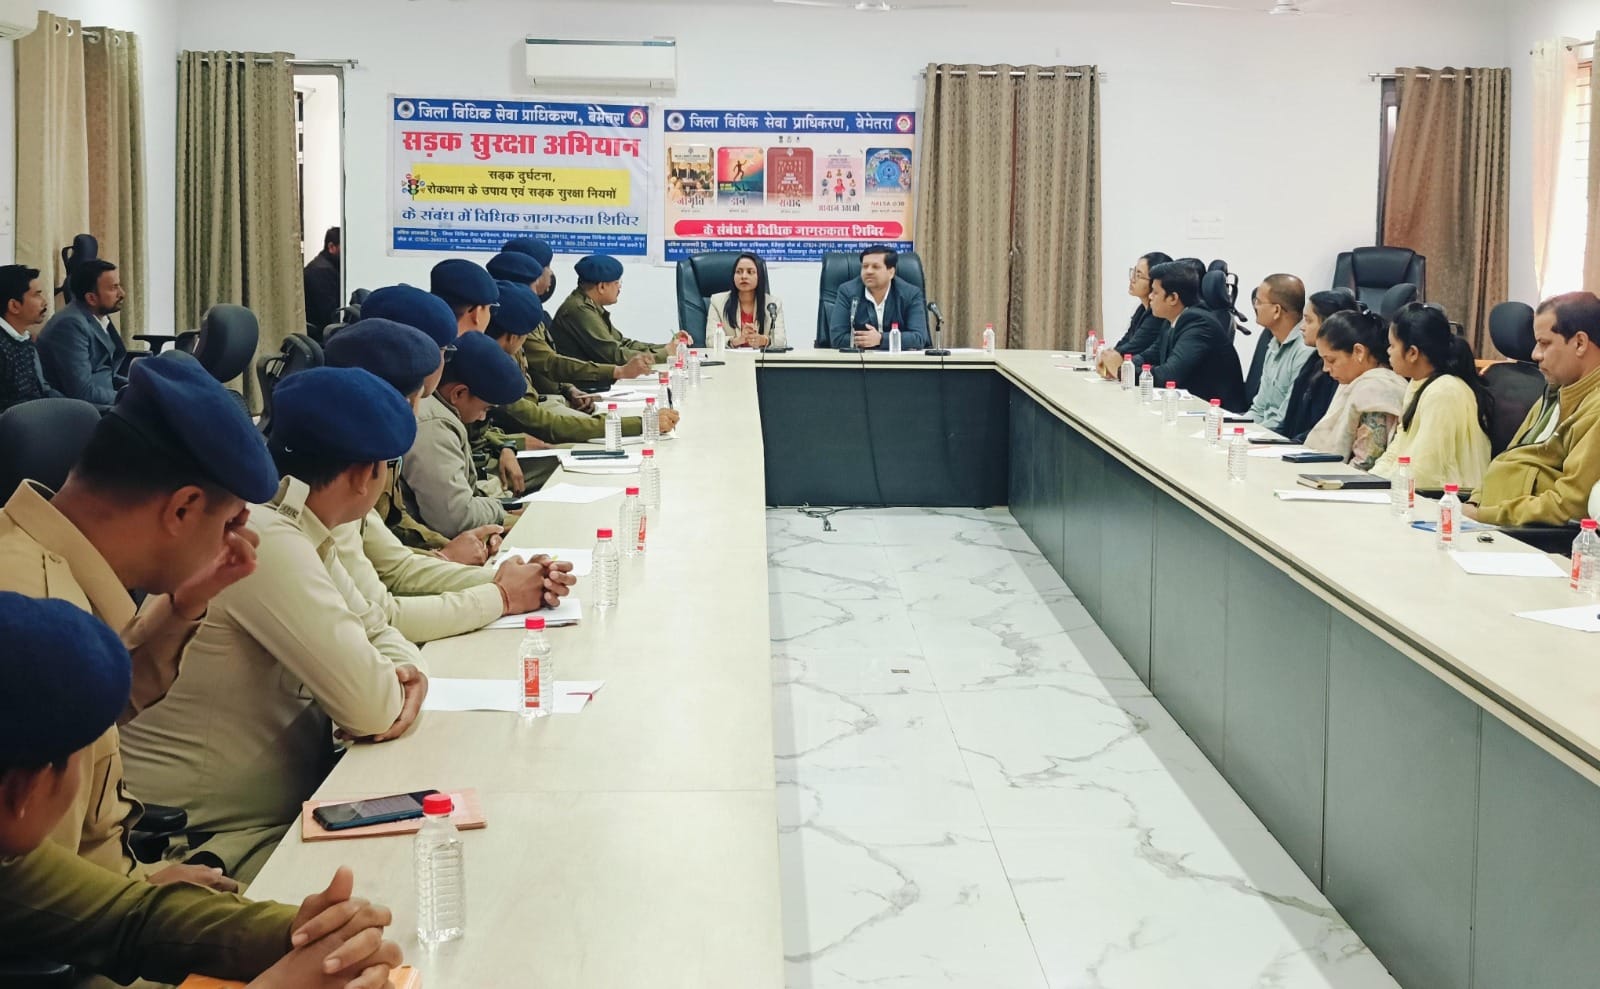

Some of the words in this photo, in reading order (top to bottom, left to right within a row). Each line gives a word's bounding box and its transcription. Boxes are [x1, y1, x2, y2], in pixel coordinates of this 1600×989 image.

[418, 101, 449, 119] जिला
[452, 102, 492, 120] विधिक
[495, 104, 518, 121] सेवा
[522, 105, 584, 125] प्राधिकरण,
[689, 112, 719, 129] जिला
[723, 113, 759, 129] विधिक
[764, 112, 788, 129] सेवा
[792, 113, 850, 131] प्राधिकरण,
[402, 131, 463, 158] सड़क
[470, 133, 537, 160] सुरक्षा
[543, 130, 641, 157] अभियान
[518, 168, 556, 184] दुर्घटना,
[427, 182, 464, 195] रोकथाम
[468, 184, 478, 195] के
[481, 186, 508, 196] उपाय
[511, 186, 525, 198] एवं
[557, 188, 584, 202] सुरक्षा
[587, 186, 617, 199] नियमों
[402, 207, 416, 220] के
[420, 207, 453, 221] संबंध
[458, 207, 473, 221] में
[475, 208, 520, 223] विधिक
[597, 211, 640, 226] शिविर
[703, 223, 714, 235] के
[716, 223, 743, 236] संबंध
[745, 223, 756, 236] में
[757, 223, 793, 236] विधिक
[851, 224, 885, 237] शिविर
